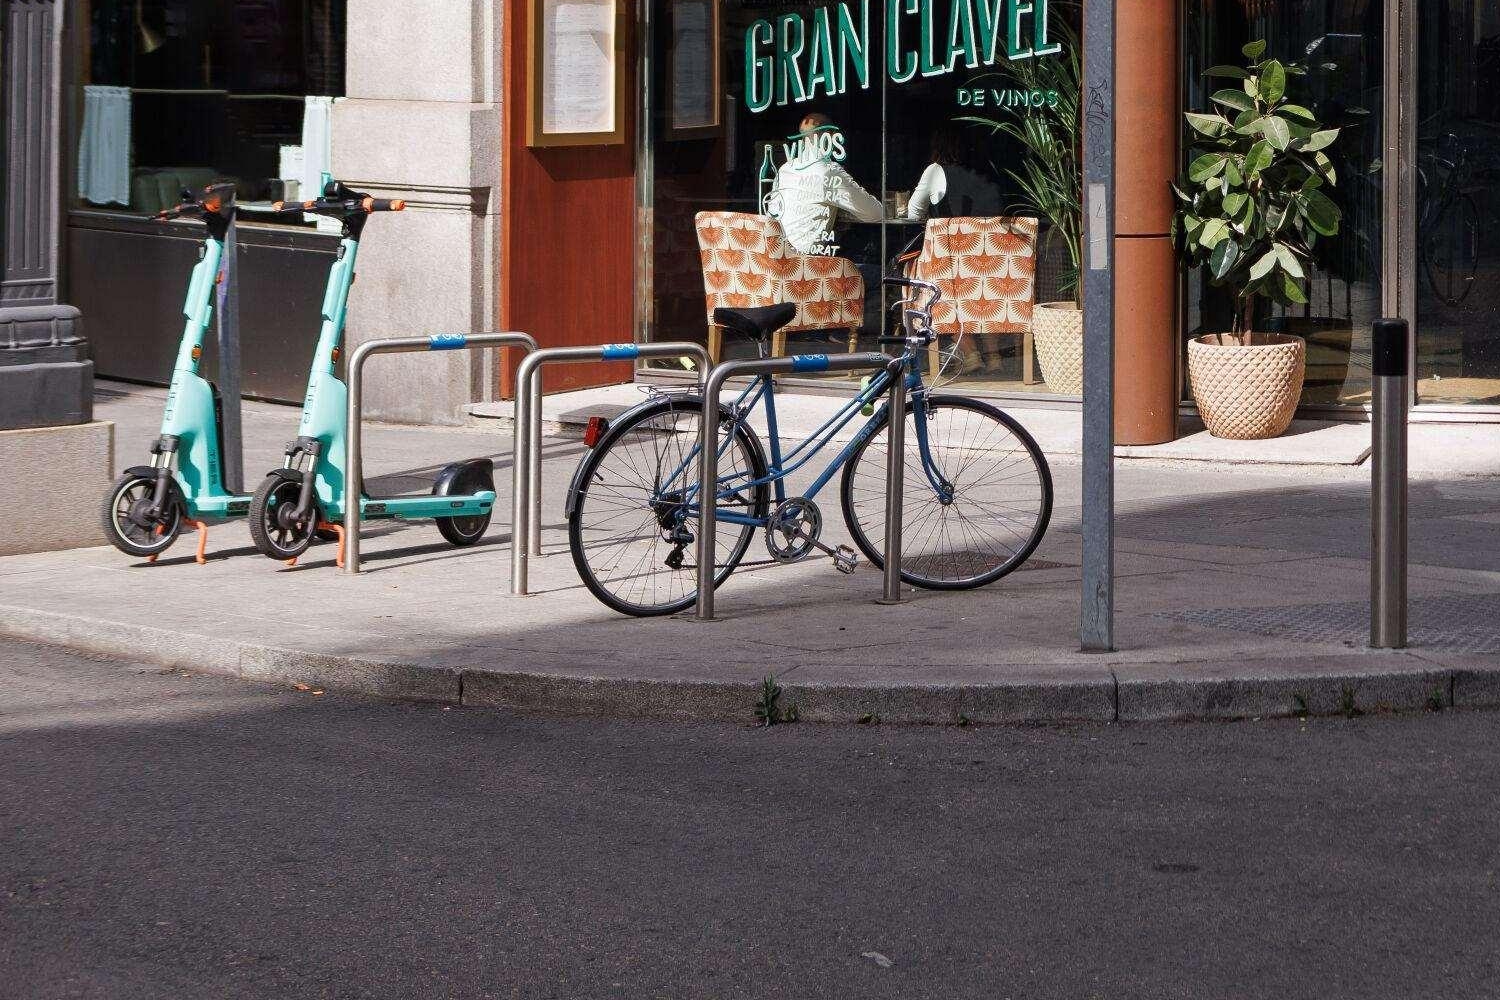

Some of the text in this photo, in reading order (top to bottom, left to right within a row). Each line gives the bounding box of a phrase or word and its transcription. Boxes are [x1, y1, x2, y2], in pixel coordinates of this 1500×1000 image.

[957, 88, 1059, 108] DE VINOS
[782, 132, 847, 163] VINOS
